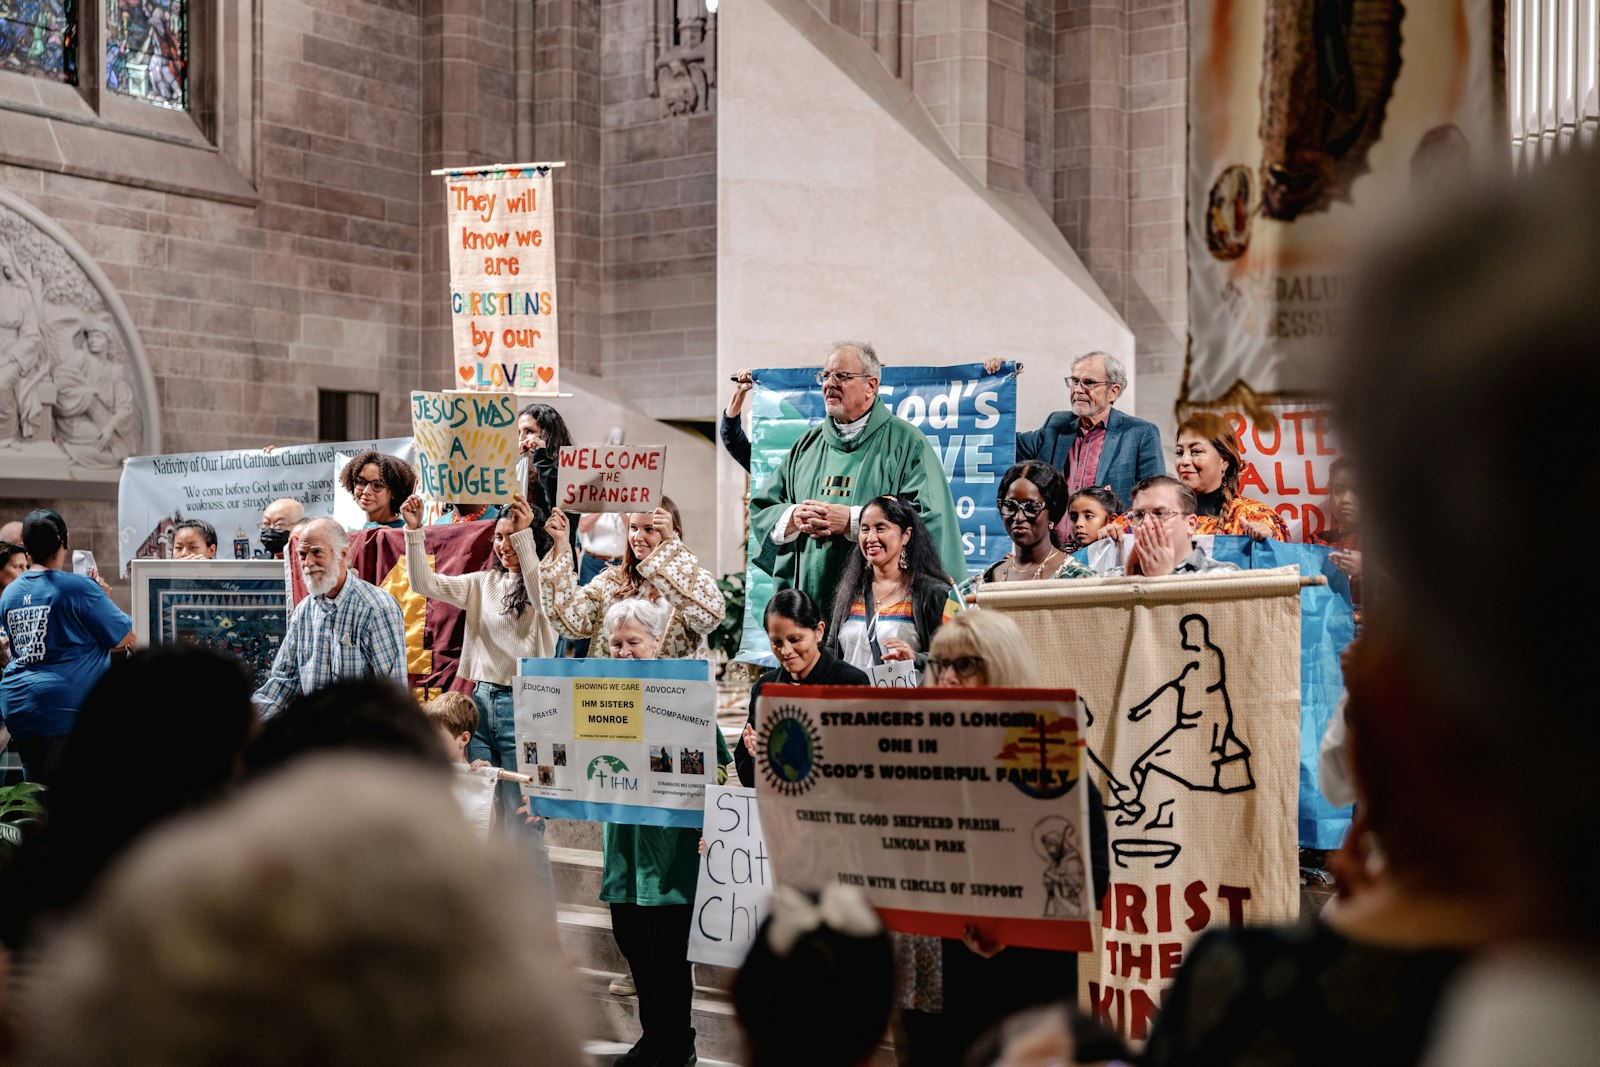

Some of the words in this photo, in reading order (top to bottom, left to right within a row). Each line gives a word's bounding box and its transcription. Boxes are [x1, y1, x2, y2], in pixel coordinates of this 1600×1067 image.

[450, 186, 496, 222] They
[506, 188, 536, 212] will
[462, 228, 510, 250] know
[516, 228, 542, 246] we
[484, 256, 520, 275] are
[452, 291, 552, 316] CHRISTIANS
[470, 321, 494, 358] by
[502, 328, 540, 348] our
[477, 363, 536, 387] LOVE
[412, 395, 468, 428] JESUS
[473, 396, 515, 428] WAS
[450, 436, 468, 461] A
[153, 458, 188, 477] Nativity
[190, 456, 200, 472] of
[201, 456, 218, 472] Our
[220, 454, 241, 471] Lord
[244, 452, 280, 468] Catholic
[282, 448, 316, 466] Church
[560, 448, 660, 470] WELCOME
[419, 452, 508, 497] REFUGEE
[599, 472, 620, 483] THE
[1238, 460, 1329, 496] ALL
[202, 488, 224, 497] come
[225, 484, 250, 496] before
[252, 481, 270, 494] God
[272, 480, 289, 492] with
[290, 482, 304, 491] our
[312, 494, 322, 502] as
[564, 484, 650, 505] STRANGER
[228, 500, 240, 510] our
[8, 608, 48, 623] RESPECT
[523, 682, 560, 694] EDUCATION
[646, 686, 686, 694] ADVOCACY
[532, 708, 558, 720] PRAYER
[582, 700, 598, 708] IHM
[600, 700, 634, 708] SISTERS
[588, 716, 628, 724] MONROE
[646, 704, 710, 728] ACCOMPANIMENT
[820, 711, 924, 727] STRANGERS
[929, 712, 956, 728] NO
[960, 712, 1037, 728] LONGER
[878, 738, 913, 754] ONE
[918, 738, 938, 754] IN
[822, 764, 875, 780] GOD'S
[880, 765, 991, 782] WONDERFUL
[611, 776, 638, 791] IHM
[796, 809, 832, 824] CHRIST
[834, 810, 856, 825] THE
[860, 813, 888, 828] GOOD
[892, 814, 954, 830] SHEPHERD
[882, 837, 930, 852] LINCOLN
[935, 840, 966, 854] PARK
[868, 875, 896, 890] WITH
[900, 878, 946, 894] CIRCLES
[950, 882, 966, 896] OF
[970, 883, 1024, 898] SUPPORT
[1106, 940, 1182, 980] THE
